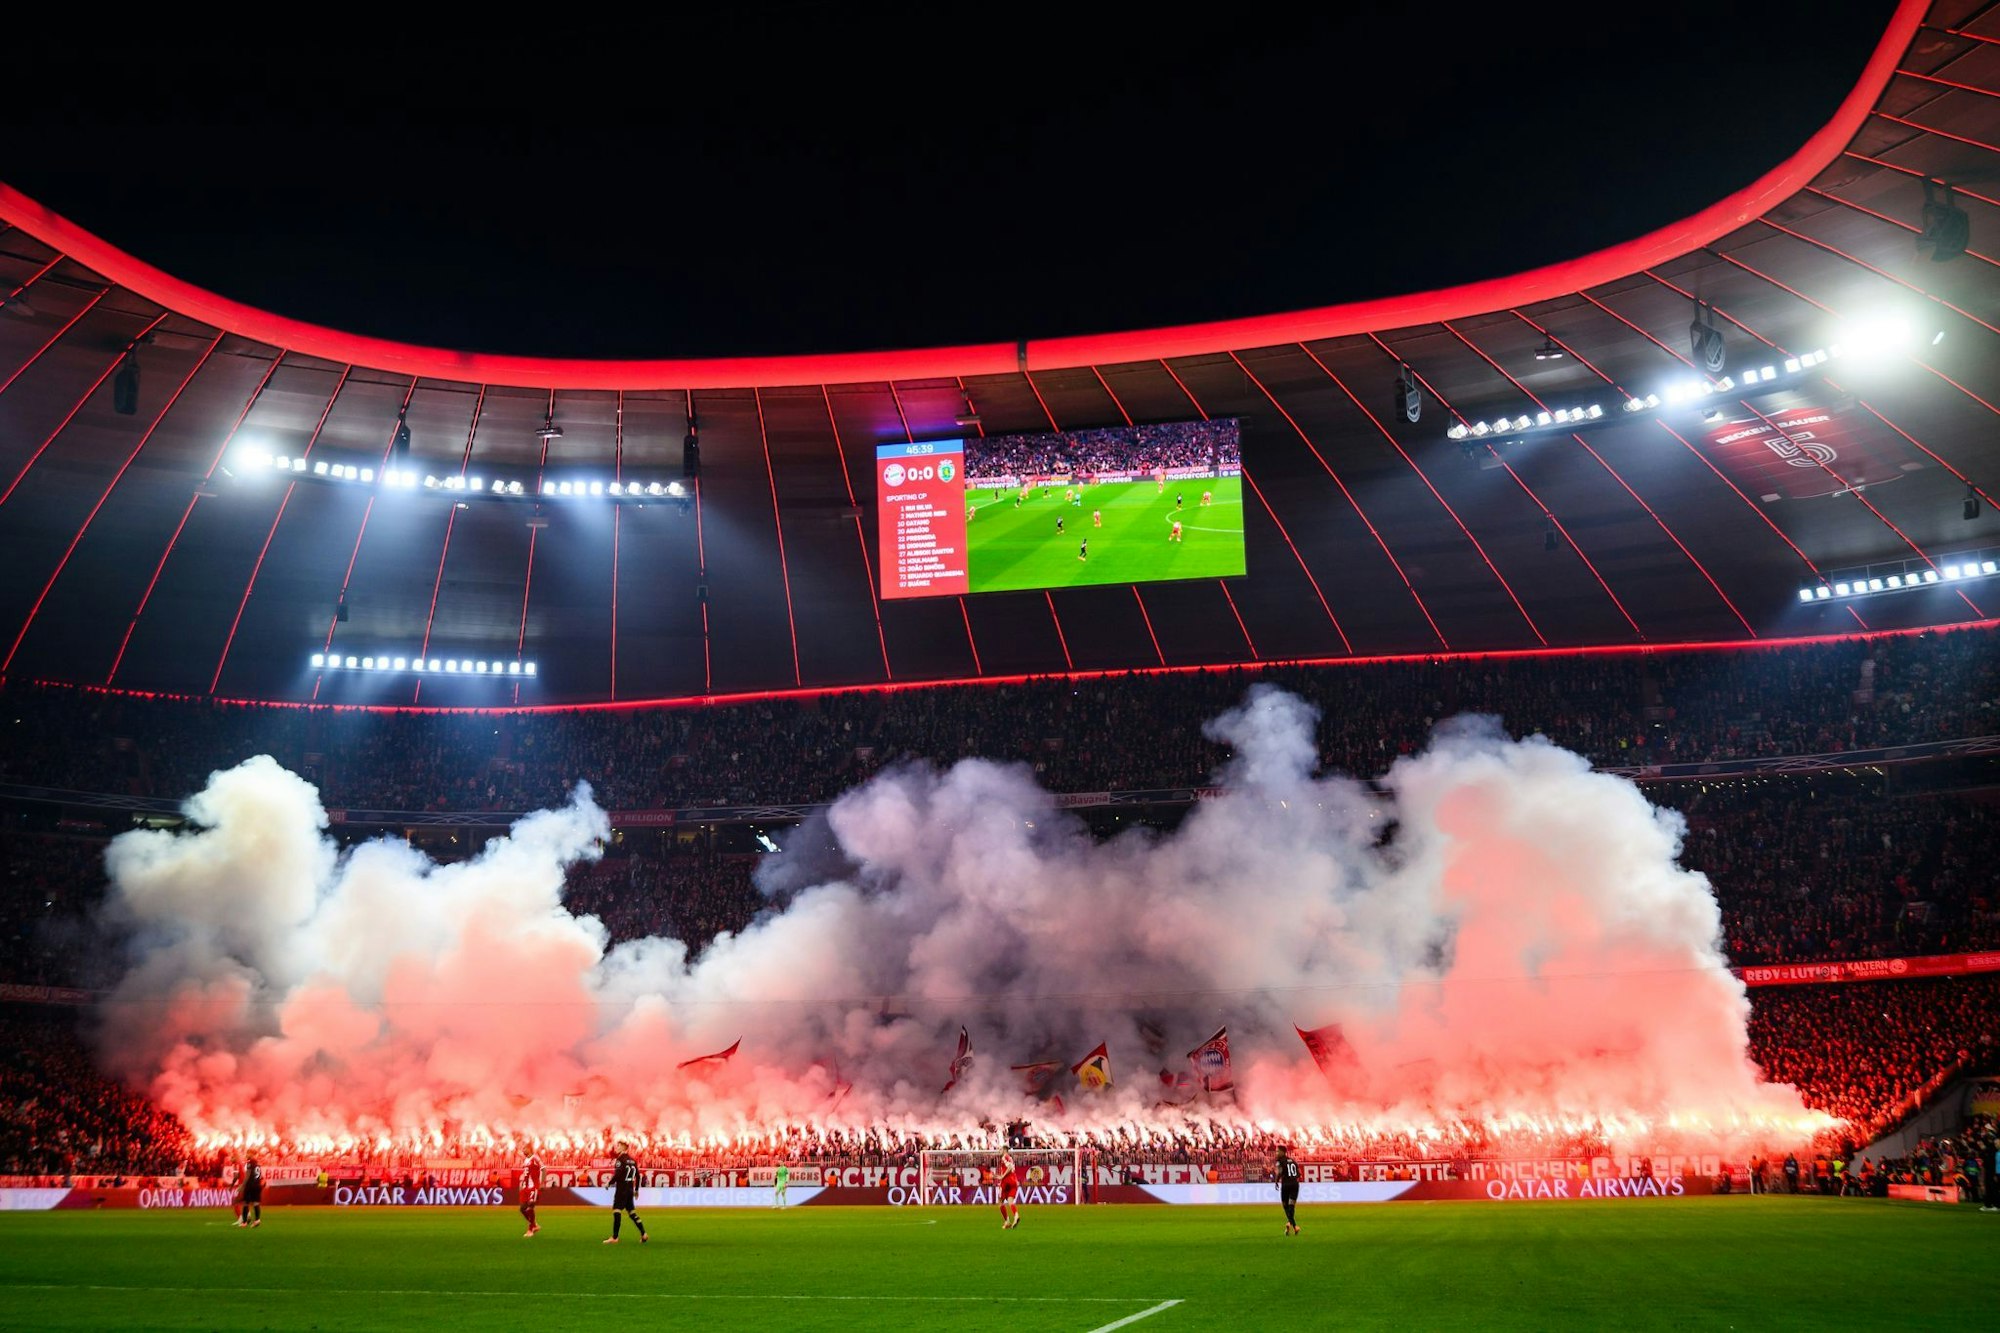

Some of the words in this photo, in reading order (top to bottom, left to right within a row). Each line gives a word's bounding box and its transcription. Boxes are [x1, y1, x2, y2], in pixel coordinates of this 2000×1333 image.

[1763, 431, 1838, 468] 5
[907, 466, 934, 481] 0:0
[1166, 471, 1214, 480] mastercard
[886, 494, 917, 502] SPORTING
[624, 814, 671, 822] RELIGION
[1846, 960, 1889, 974] KALTERN
[266, 1167, 317, 1180] BRETTEN
[753, 1171, 772, 1181] RED
[1287, 1163, 1298, 1177] 10
[887, 1186, 962, 1205] QATAR
[1227, 1184, 1342, 1203] pricess
[1486, 1178, 1570, 1200] QATAR
[1580, 1176, 1685, 1198] AIRWAYS
[139, 1188, 185, 1208] QATAR
[335, 1187, 406, 1206] QATAR
[414, 1187, 504, 1206] AIRWAYS
[670, 1187, 774, 1206] priceless
